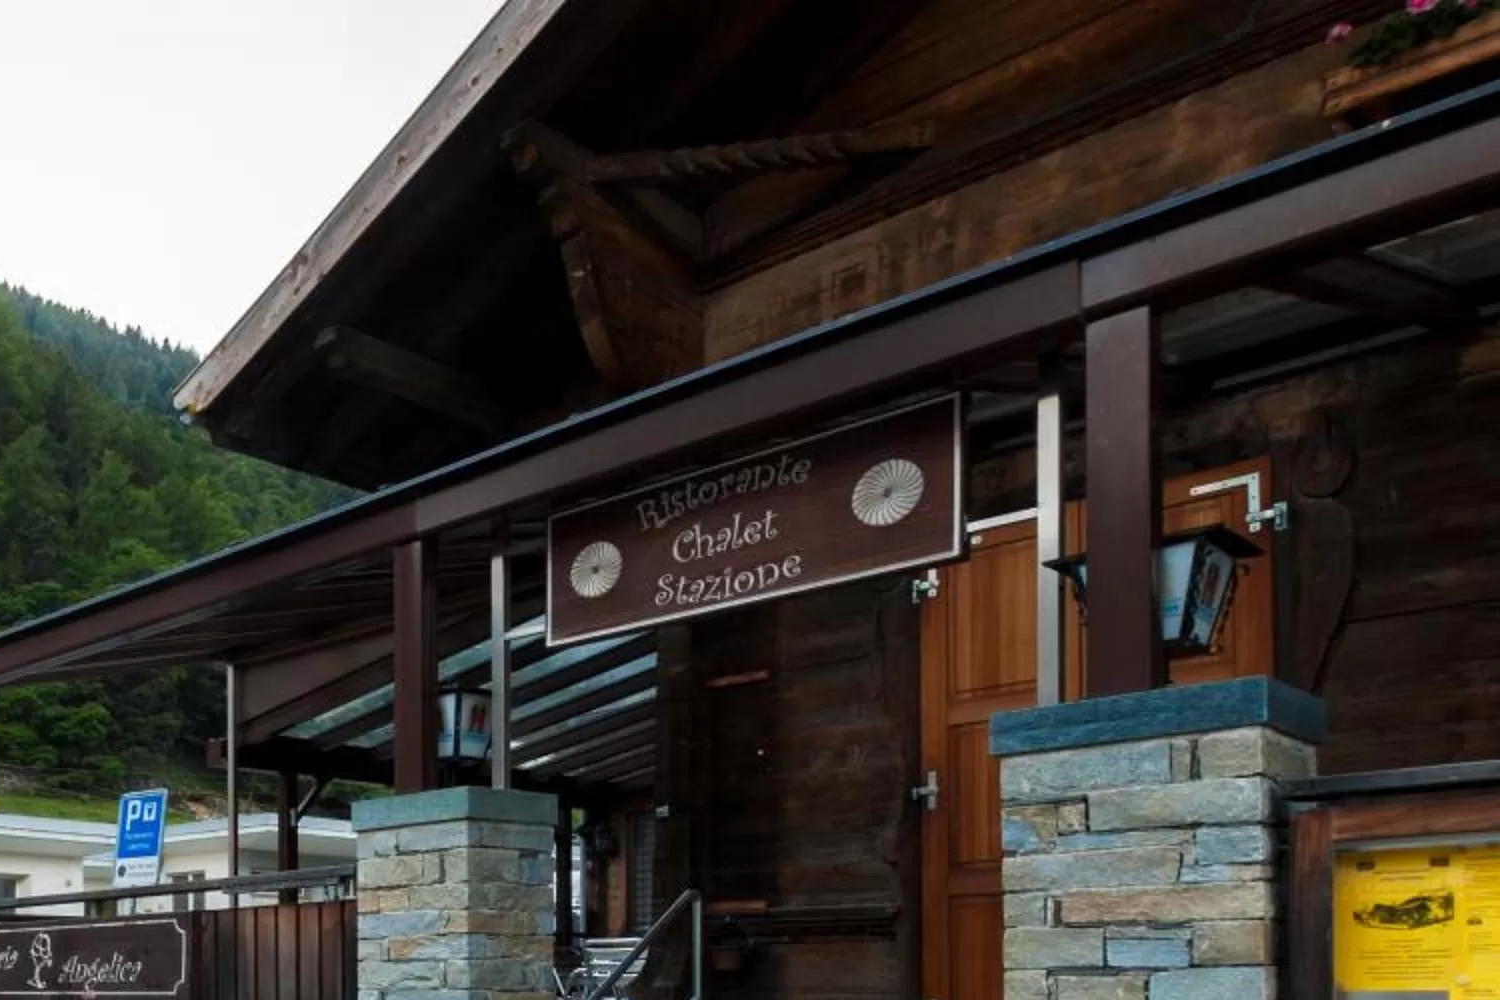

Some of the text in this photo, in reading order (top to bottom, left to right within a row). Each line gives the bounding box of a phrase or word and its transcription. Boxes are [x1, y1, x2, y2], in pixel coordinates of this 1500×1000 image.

[635, 453, 812, 532] Ristorante
[672, 509, 779, 563] Chalet
[654, 553, 802, 606] Stazione
[126, 800, 142, 831] P
[58, 952, 143, 992] Angelica
